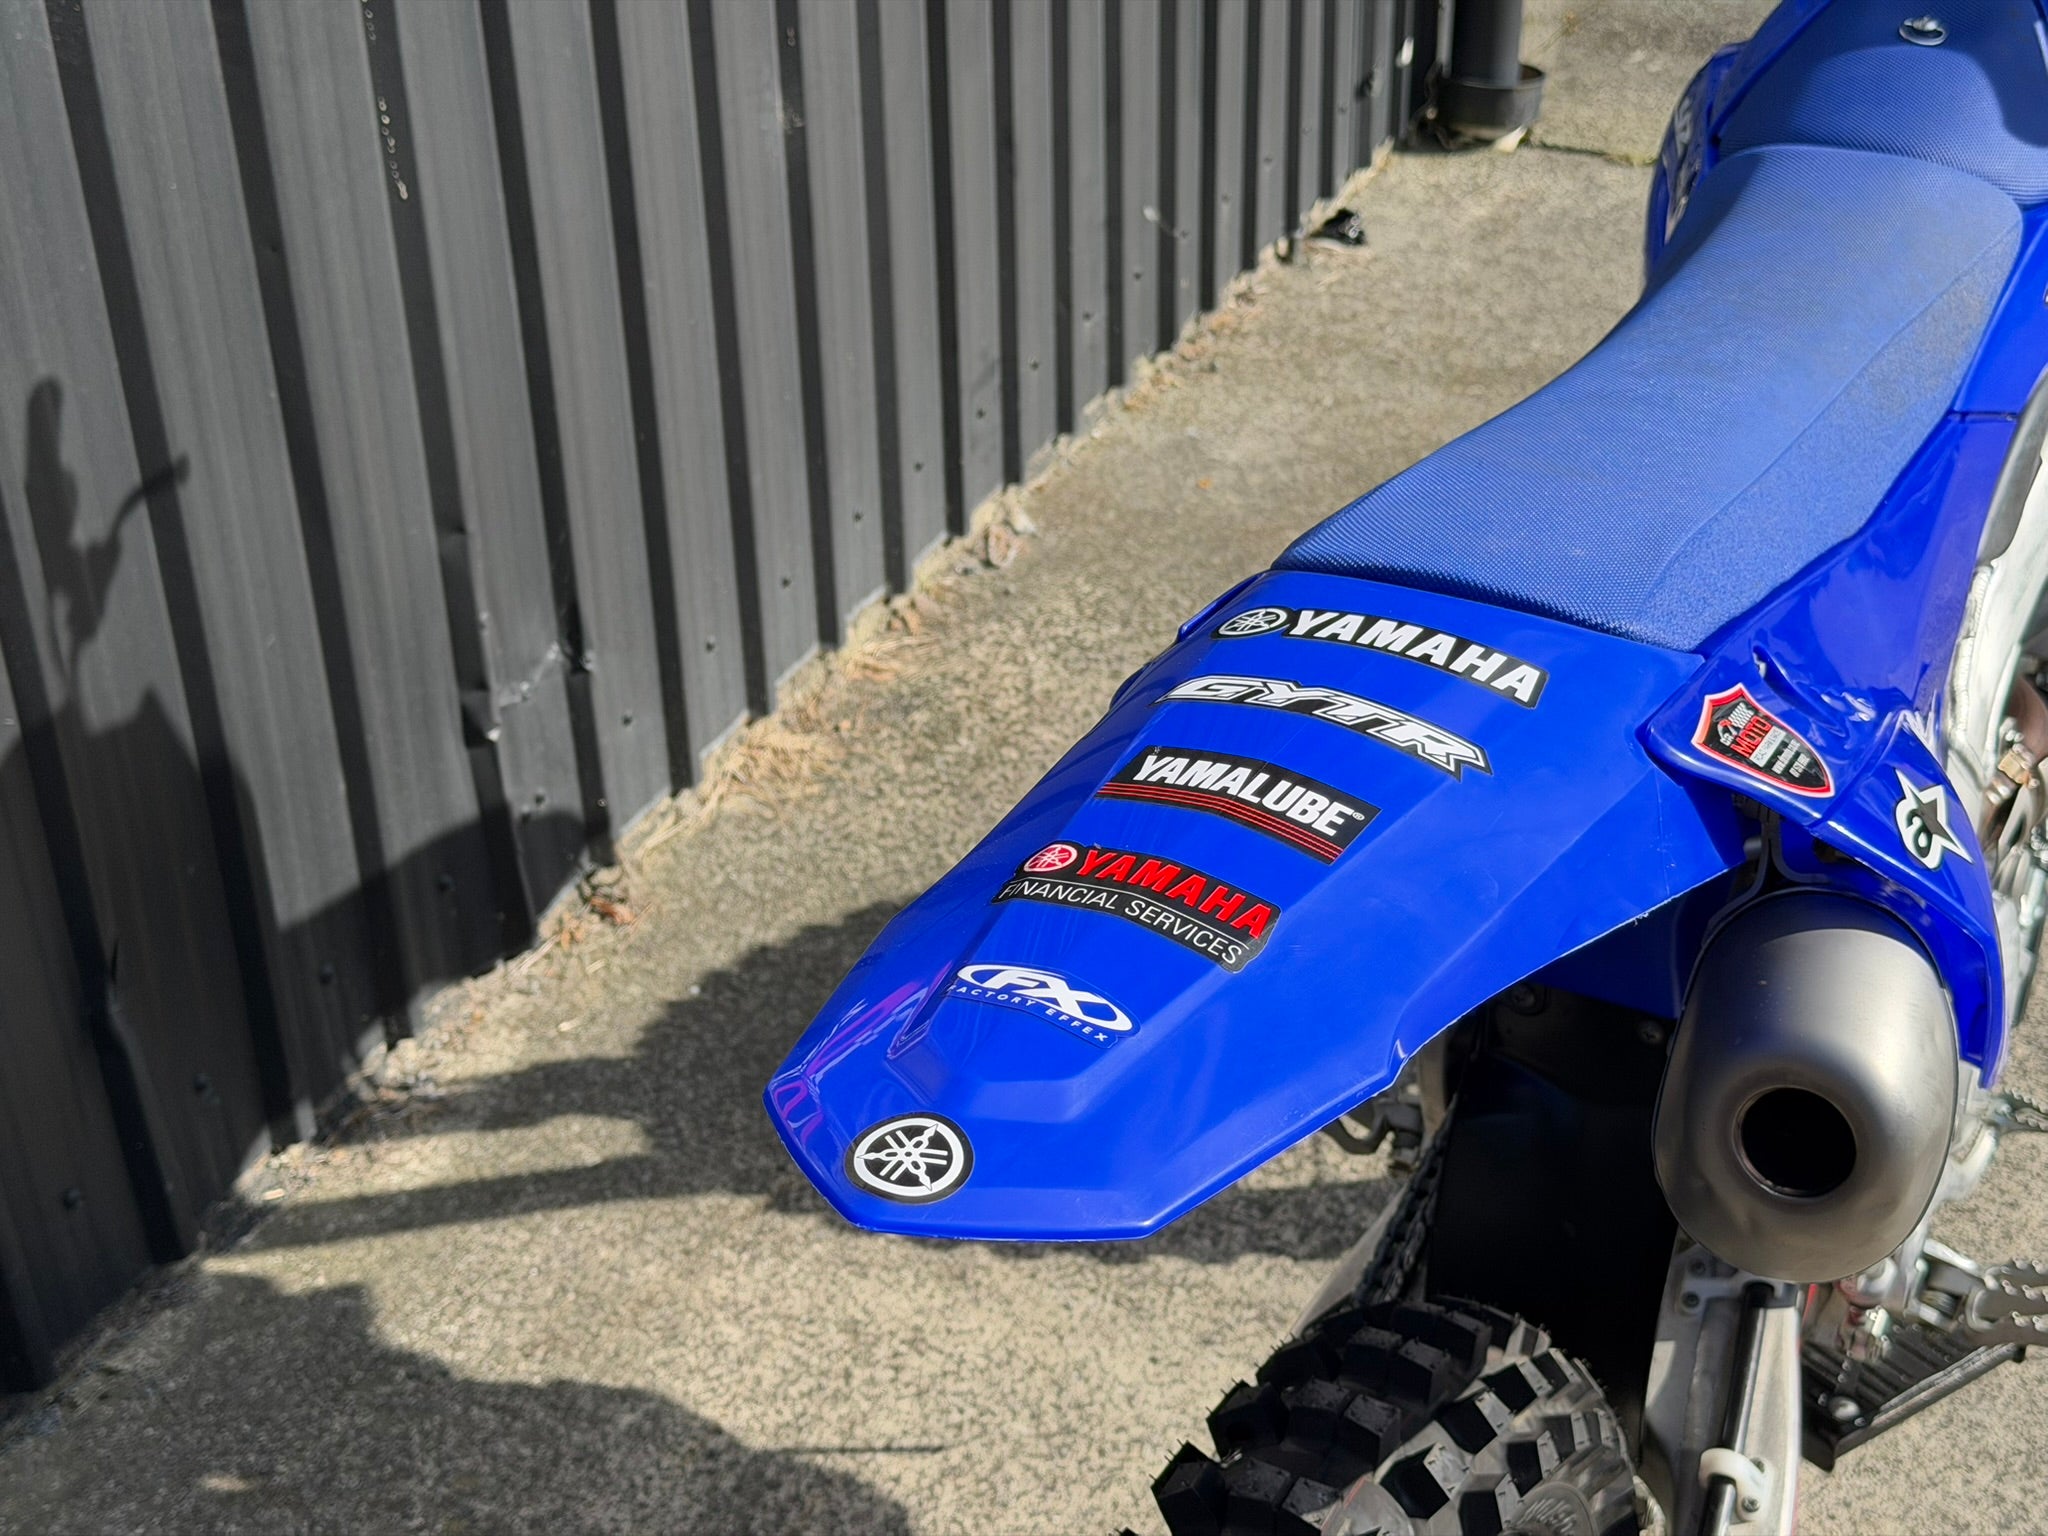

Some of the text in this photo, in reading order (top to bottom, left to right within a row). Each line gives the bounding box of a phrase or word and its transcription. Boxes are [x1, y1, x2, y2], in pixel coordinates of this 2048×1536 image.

[1288, 609, 1541, 703] YAMAHA
[1154, 676, 1485, 773] GYTR
[1730, 715, 1773, 758] MOTO
[997, 879, 1243, 965] FINANCIAL SERVICES
[1075, 849, 1274, 940] YAMAHA
[947, 984, 1108, 1042] FACTORY EFFEX
[976, 967, 1116, 1020] FX
